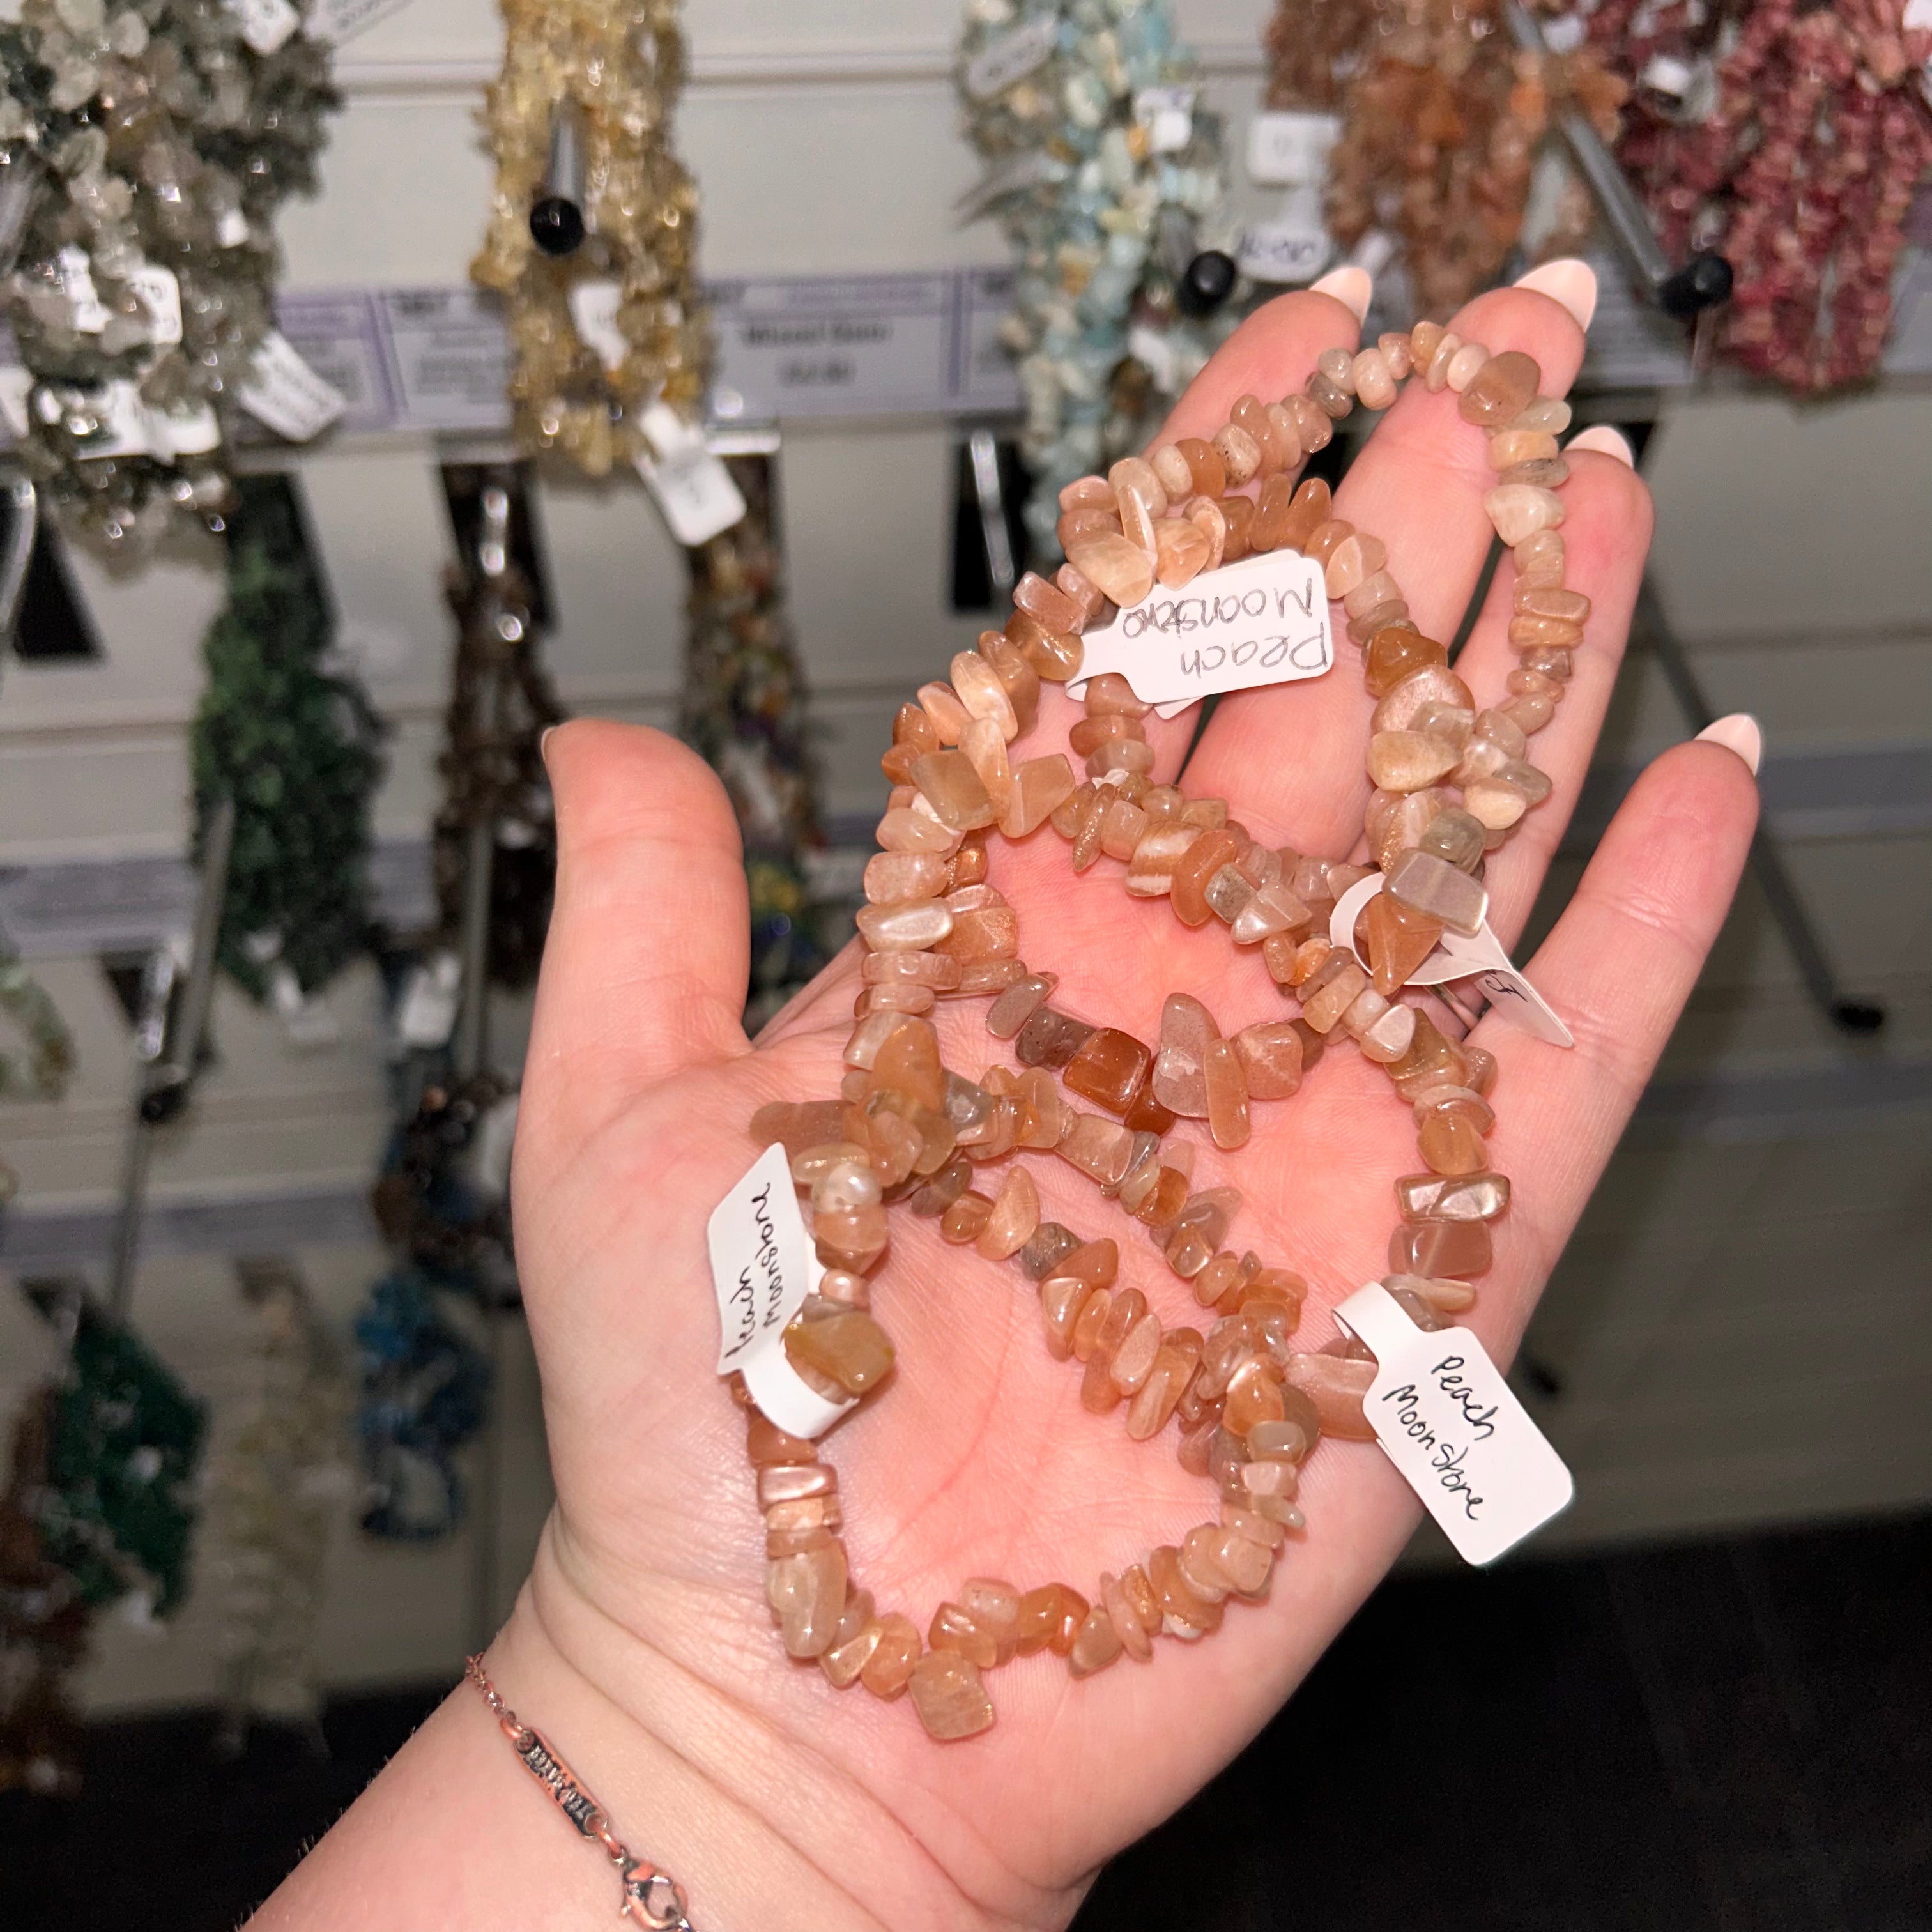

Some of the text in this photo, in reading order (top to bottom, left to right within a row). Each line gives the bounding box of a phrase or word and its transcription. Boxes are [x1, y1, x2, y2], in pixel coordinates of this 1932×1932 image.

[1180, 622, 1329, 680] Peach
[751, 1181, 784, 1329] Moonstone
[1430, 1354, 1498, 1441] Peach
